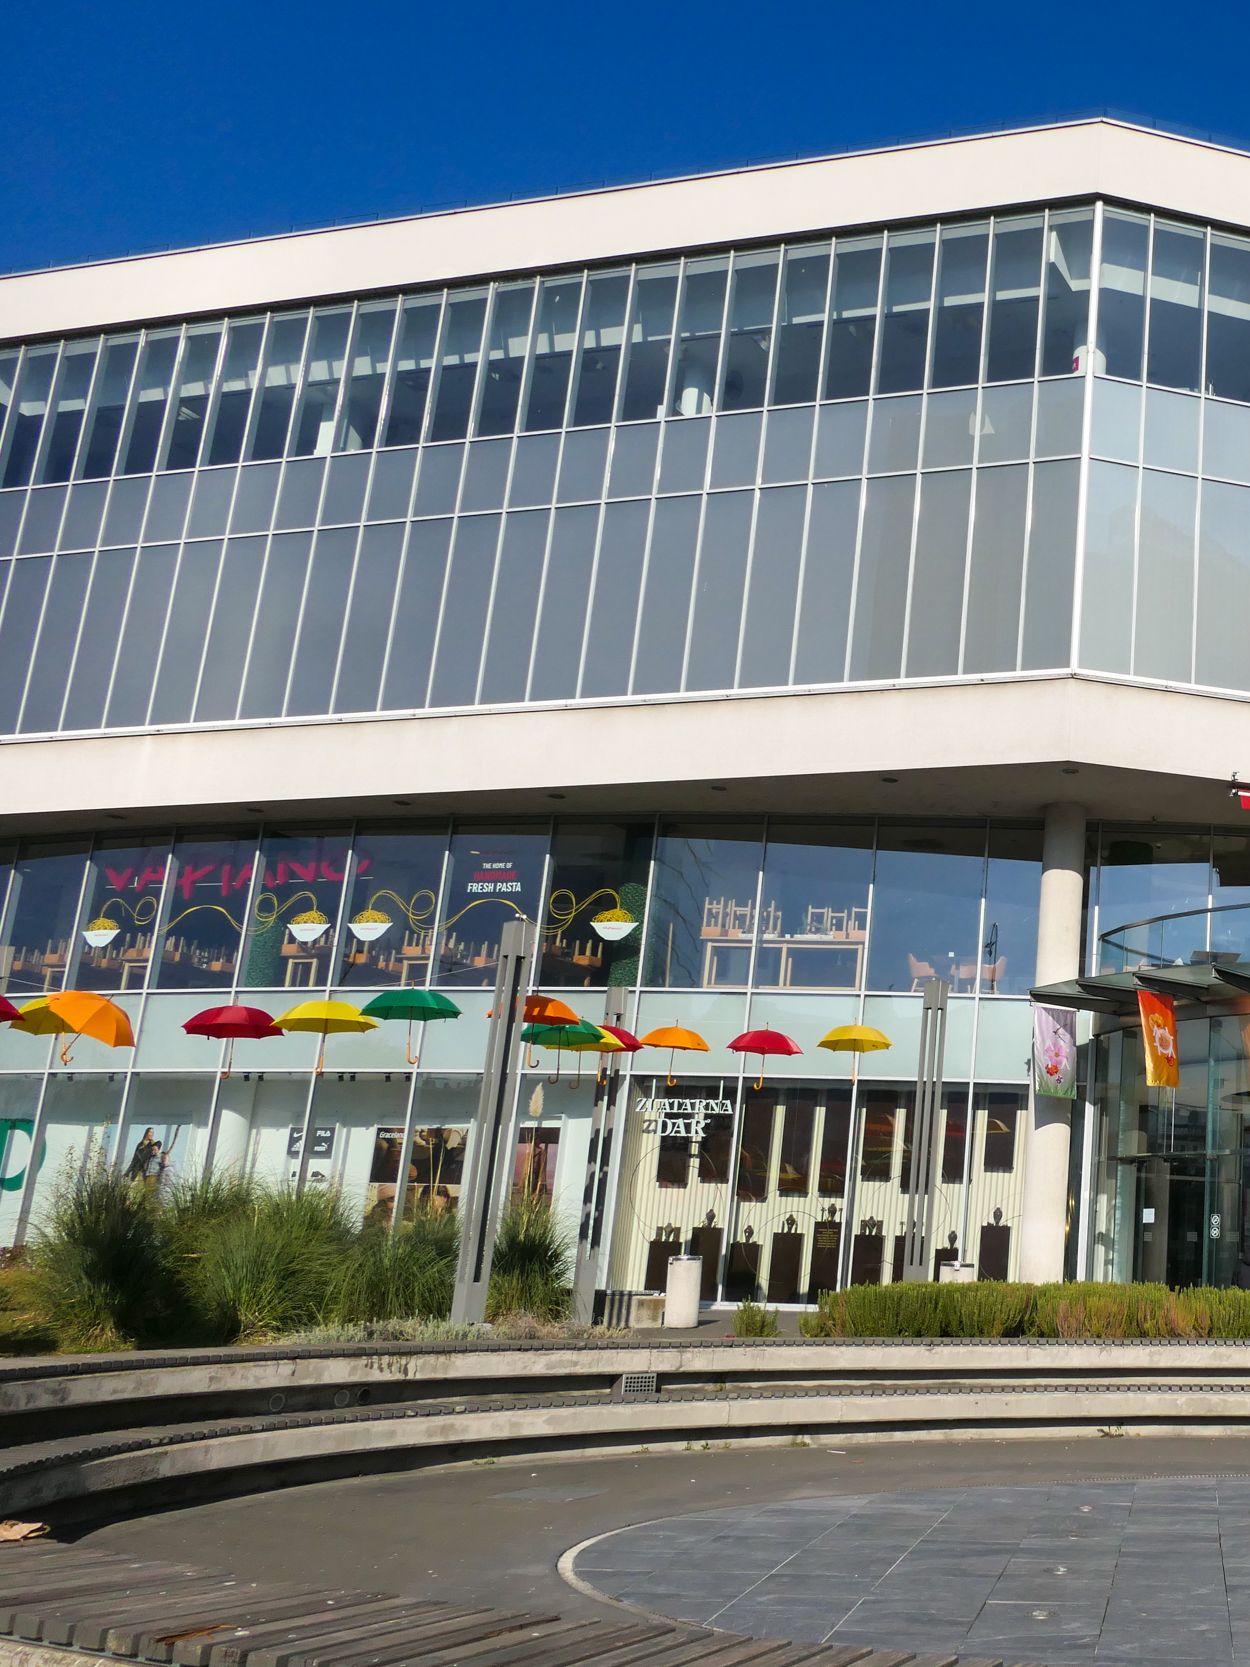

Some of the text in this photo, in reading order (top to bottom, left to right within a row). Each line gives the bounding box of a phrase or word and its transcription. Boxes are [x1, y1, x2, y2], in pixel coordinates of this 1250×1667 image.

[467, 882, 521, 893] FRESH PASTA
[636, 1098, 733, 1114] ZLATARNA
[380, 1131, 405, 1139] Gracelan
